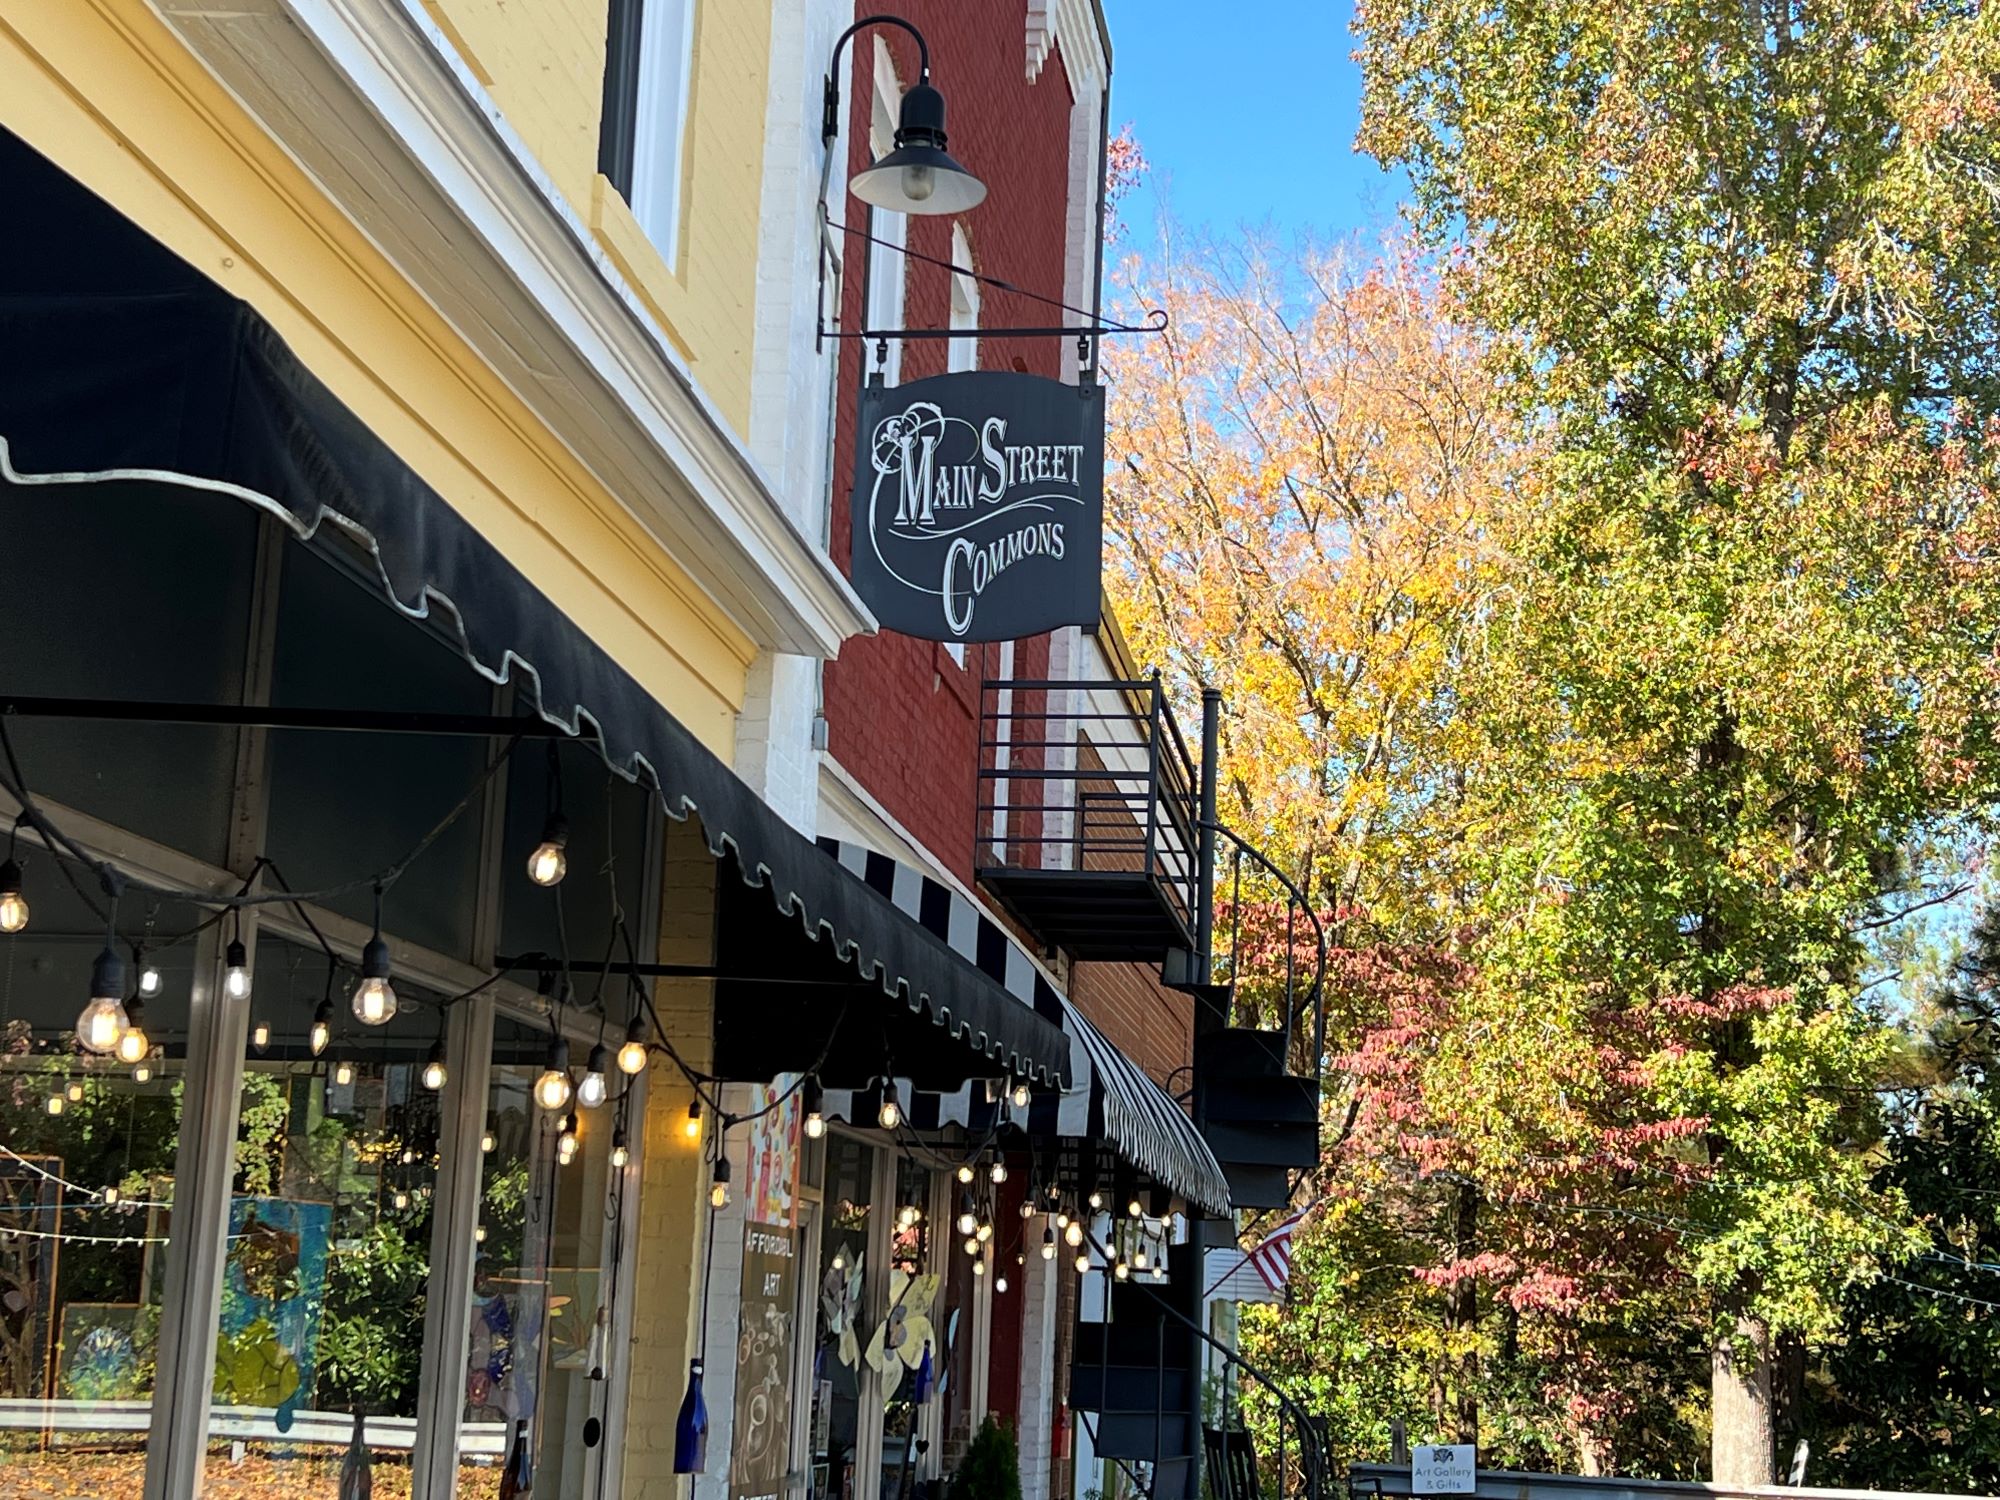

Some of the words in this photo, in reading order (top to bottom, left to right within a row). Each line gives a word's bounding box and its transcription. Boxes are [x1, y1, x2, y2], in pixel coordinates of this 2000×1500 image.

[978, 417, 1084, 504] STREET
[943, 523, 1064, 636] COMMONS
[762, 1273, 781, 1296] ART
[1415, 1468, 1430, 1477] Art
[1433, 1467, 1471, 1478] Gallery
[1427, 1481, 1433, 1489] &
[1436, 1480, 1461, 1489] Gifts
